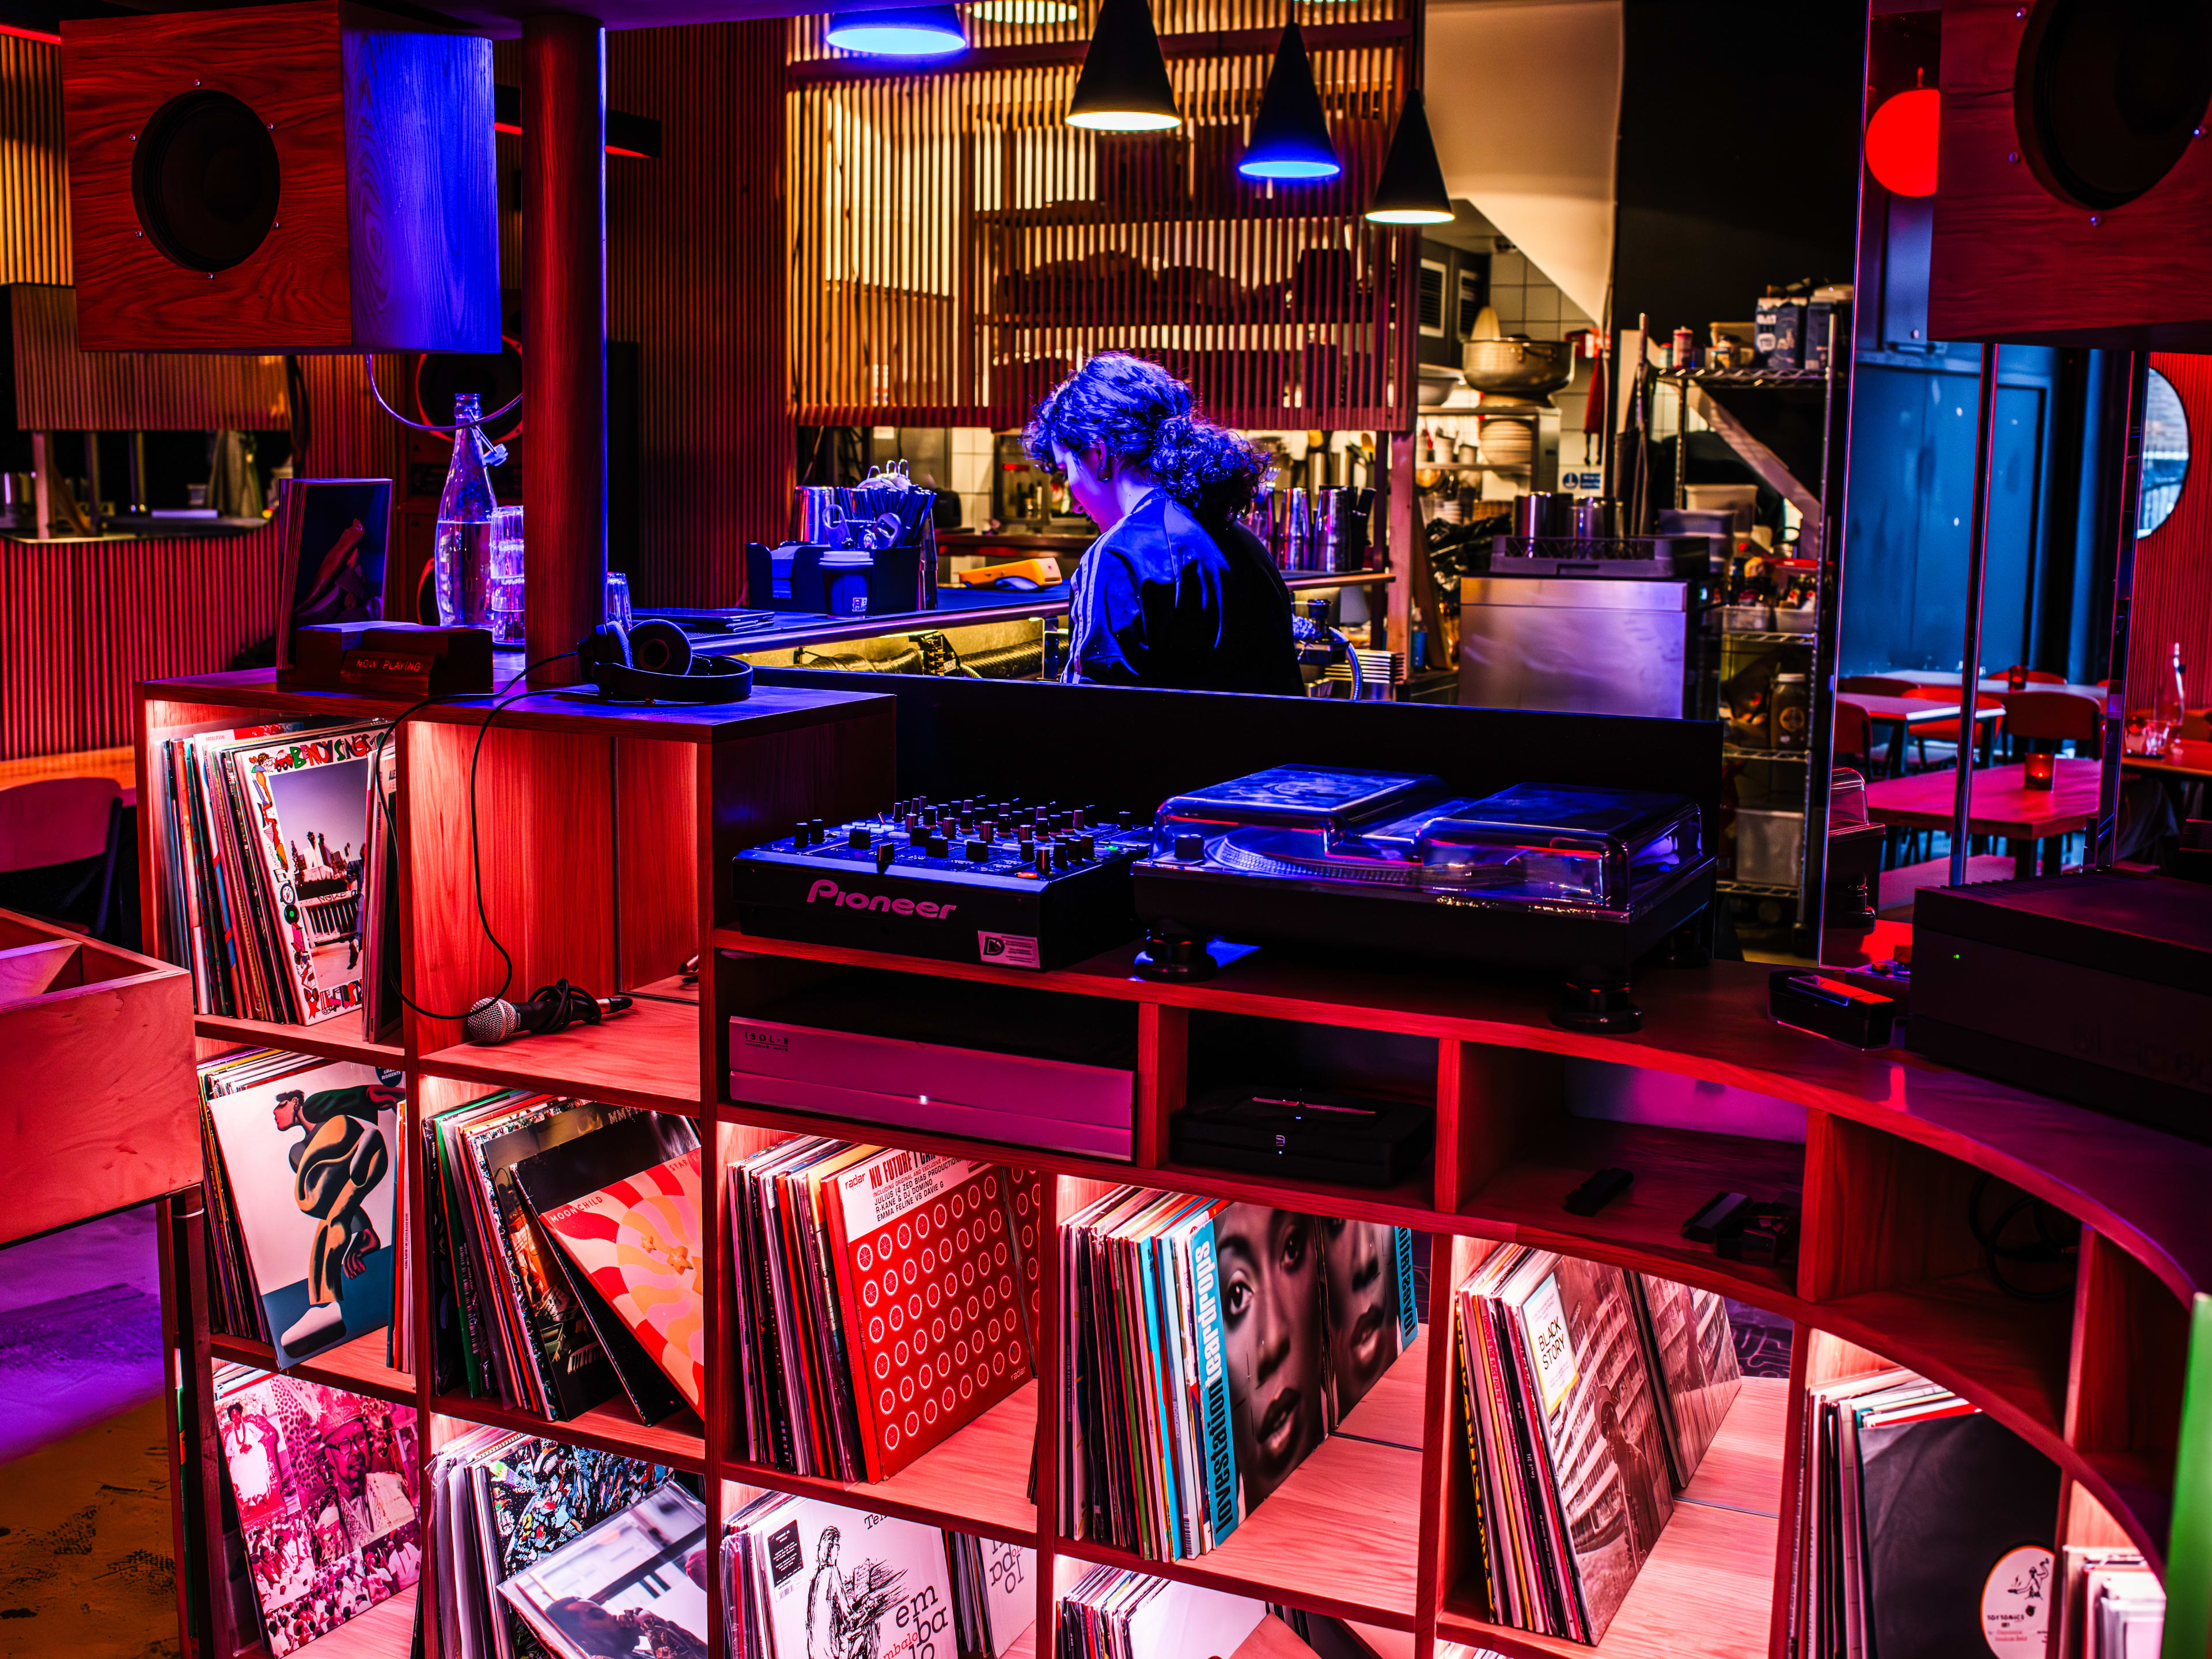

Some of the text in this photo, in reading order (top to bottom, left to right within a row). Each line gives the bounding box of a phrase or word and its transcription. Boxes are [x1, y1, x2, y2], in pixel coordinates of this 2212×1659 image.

[357, 659, 421, 672] NOW PLAYING
[806, 879, 957, 920] Pioneer
[745, 1032, 789, 1045] ISOL-8
[845, 1173, 865, 1190] radar
[869, 1165, 882, 1190] NU
[882, 1151, 912, 1183] FUTURE
[873, 1184, 894, 1198] INCLUDING
[895, 1175, 912, 1187] ORIGINAL
[922, 1160, 941, 1172] EXCLUSIVE
[875, 1191, 893, 1206] JULIUS
[903, 1180, 913, 1191] ZED
[915, 1173, 926, 1185] BIAS
[876, 1198, 896, 1214] R-KANE
[904, 1191, 910, 1199] DJ
[912, 1179, 933, 1195] DOMINO
[877, 1209, 895, 1222] EMMA
[896, 1200, 914, 1212] FELINE
[915, 1194, 922, 1202] VS
[924, 1186, 938, 1197] DAVIE
[550, 1196, 603, 1223] MOONCHILD
[1195, 1241, 1222, 1389] teardrops
[1538, 1316, 1561, 1352] BLACK
[1542, 1333, 1565, 1370] STORY
[1011, 1366, 1025, 1381] radar
[1209, 1377, 1233, 1535] lovestation
[896, 1585, 938, 1628] em
[913, 1607, 948, 1648] ba
